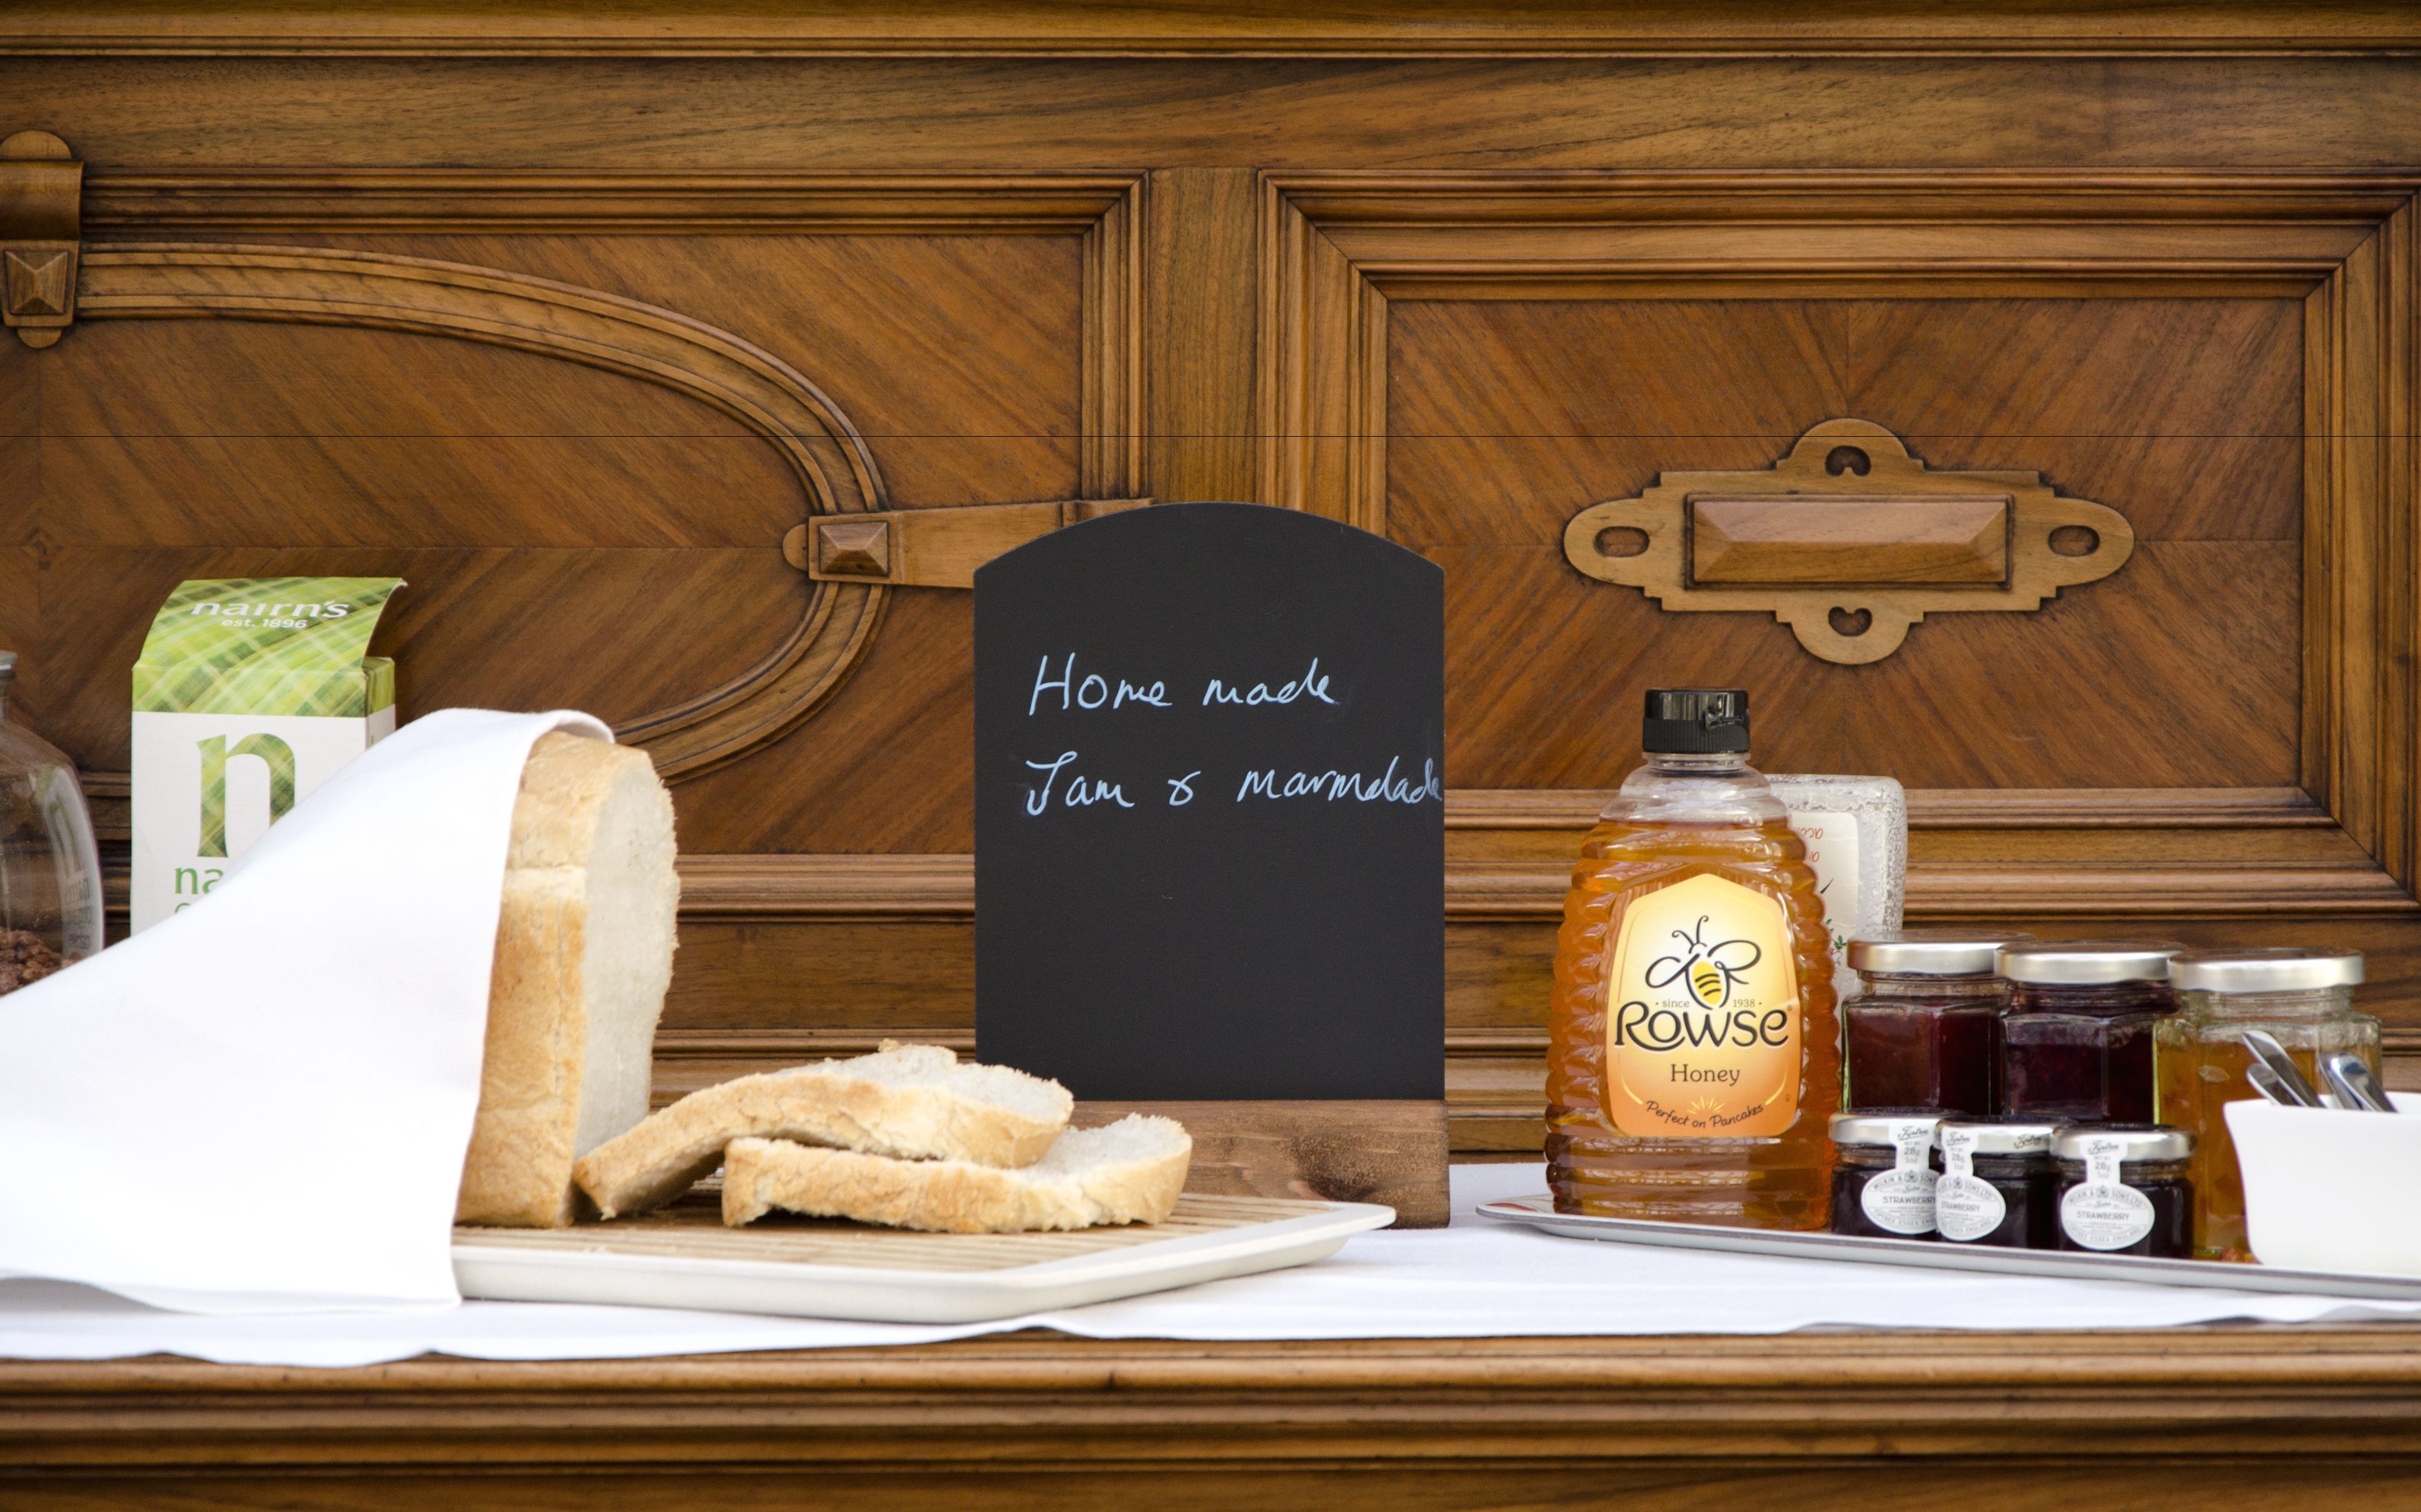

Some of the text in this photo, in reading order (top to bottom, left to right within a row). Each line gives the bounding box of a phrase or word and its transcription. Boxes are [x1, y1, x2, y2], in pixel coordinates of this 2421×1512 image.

[190, 600, 350, 619] nairn's
[221, 618, 308, 629] est. 1896
[1029, 652, 1338, 715] Home made
[1026, 751, 1135, 816] Jam
[1662, 999, 1755, 1008] since 1938
[1671, 1064, 1740, 1086] Honey
[1647, 1100, 1764, 1128] Perfect on Pancakes
[1904, 1146, 1921, 1157] 28g
[2095, 1161, 2111, 1171] 28g
[2077, 1211, 2130, 1220] STRAWBERRY
